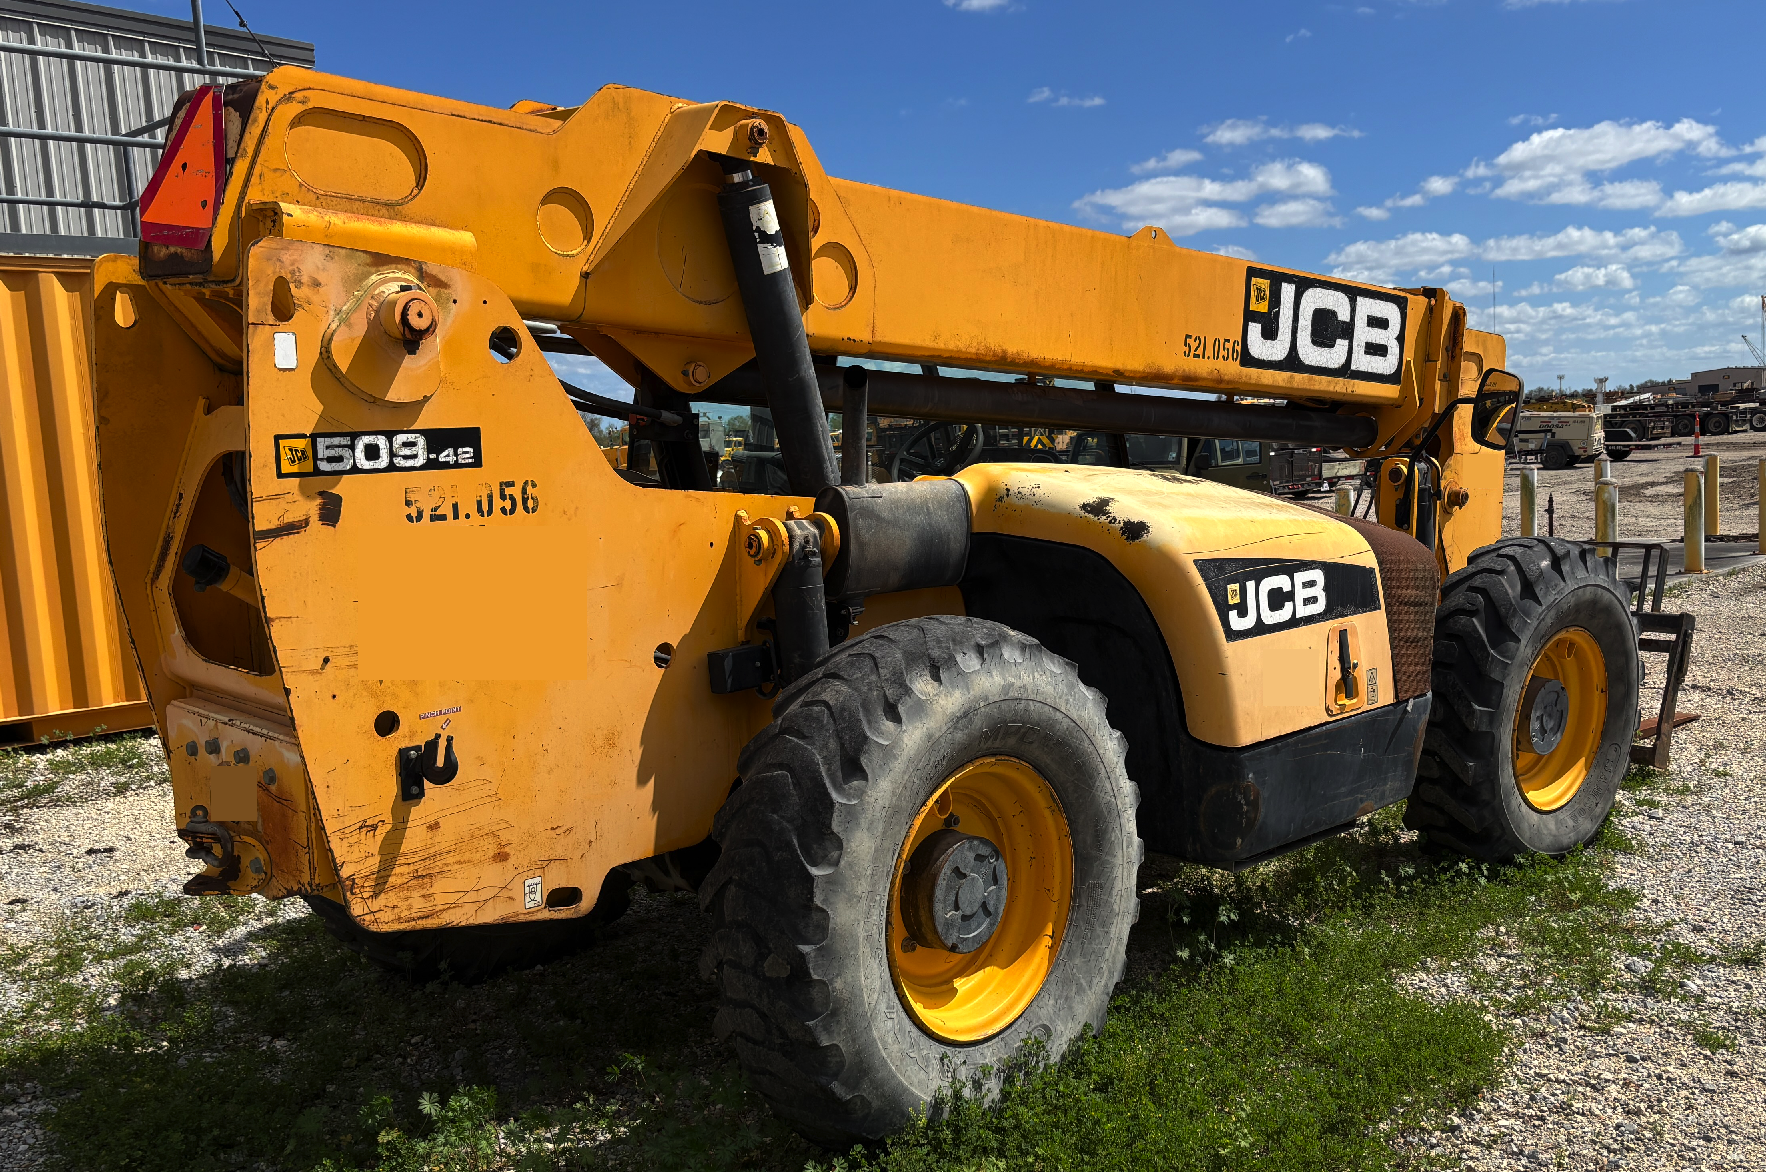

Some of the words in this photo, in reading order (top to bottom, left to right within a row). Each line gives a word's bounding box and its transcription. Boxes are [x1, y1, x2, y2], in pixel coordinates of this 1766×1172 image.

[1247, 281, 1402, 376] JCB
[1183, 334, 1240, 363] 521.056
[286, 446, 309, 465] JCB
[316, 433, 475, 472] 509-42
[404, 479, 539, 524] 521.056
[1228, 568, 1327, 631] JCB
[420, 711, 440, 719] PINCH
[441, 706, 461, 715] POINT
